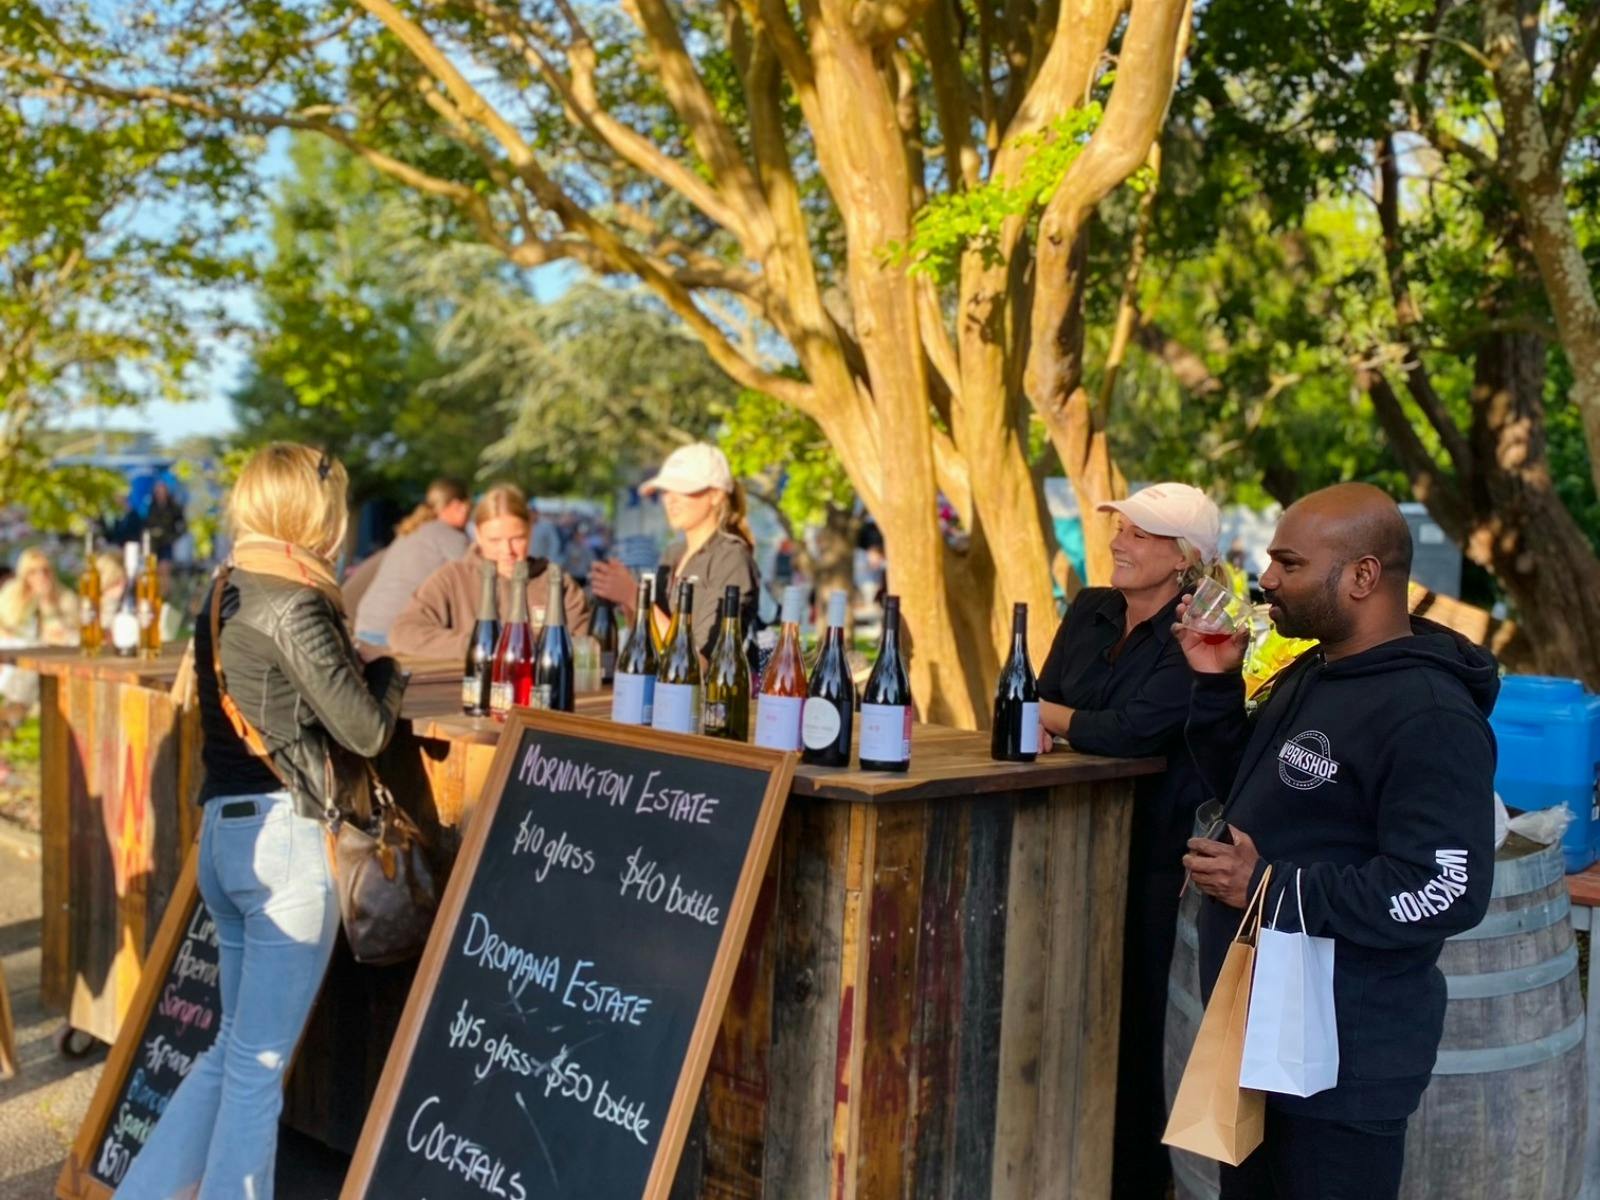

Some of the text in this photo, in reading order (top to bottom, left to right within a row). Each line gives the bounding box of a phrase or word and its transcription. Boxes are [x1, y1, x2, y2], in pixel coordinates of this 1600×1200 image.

[518, 744, 720, 823] MORNINGTON ESTATE
[1278, 741, 1339, 780] WORKSHOP
[512, 810, 720, 925] $10 glass $40 bottle
[1389, 849, 1468, 923] WORKSHOP
[463, 913, 652, 1025] DROMANA ESTATE
[449, 999, 650, 1145] $15 glass $50 bottle
[406, 1096, 527, 1200] COCKTAILS
